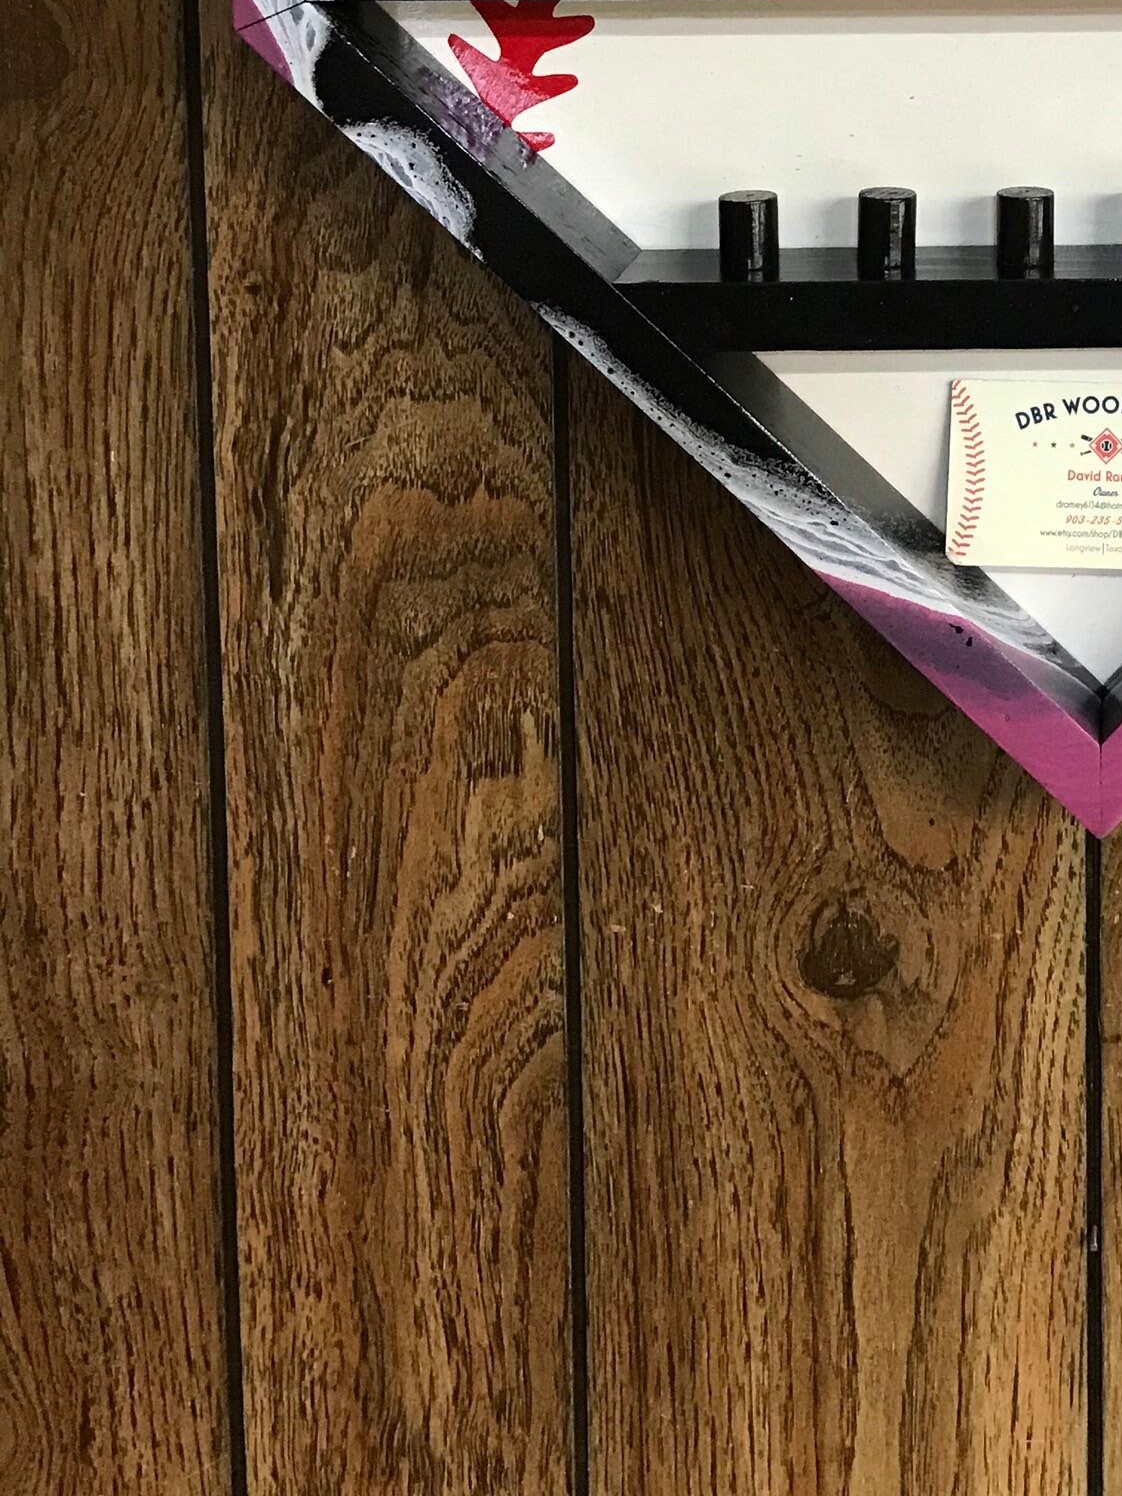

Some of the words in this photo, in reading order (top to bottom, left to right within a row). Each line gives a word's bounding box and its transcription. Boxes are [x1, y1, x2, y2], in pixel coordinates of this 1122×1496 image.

[1015, 402, 1058, 430] DBR
[1067, 470, 1101, 482] David
[1093, 486, 1119, 497] Owner
